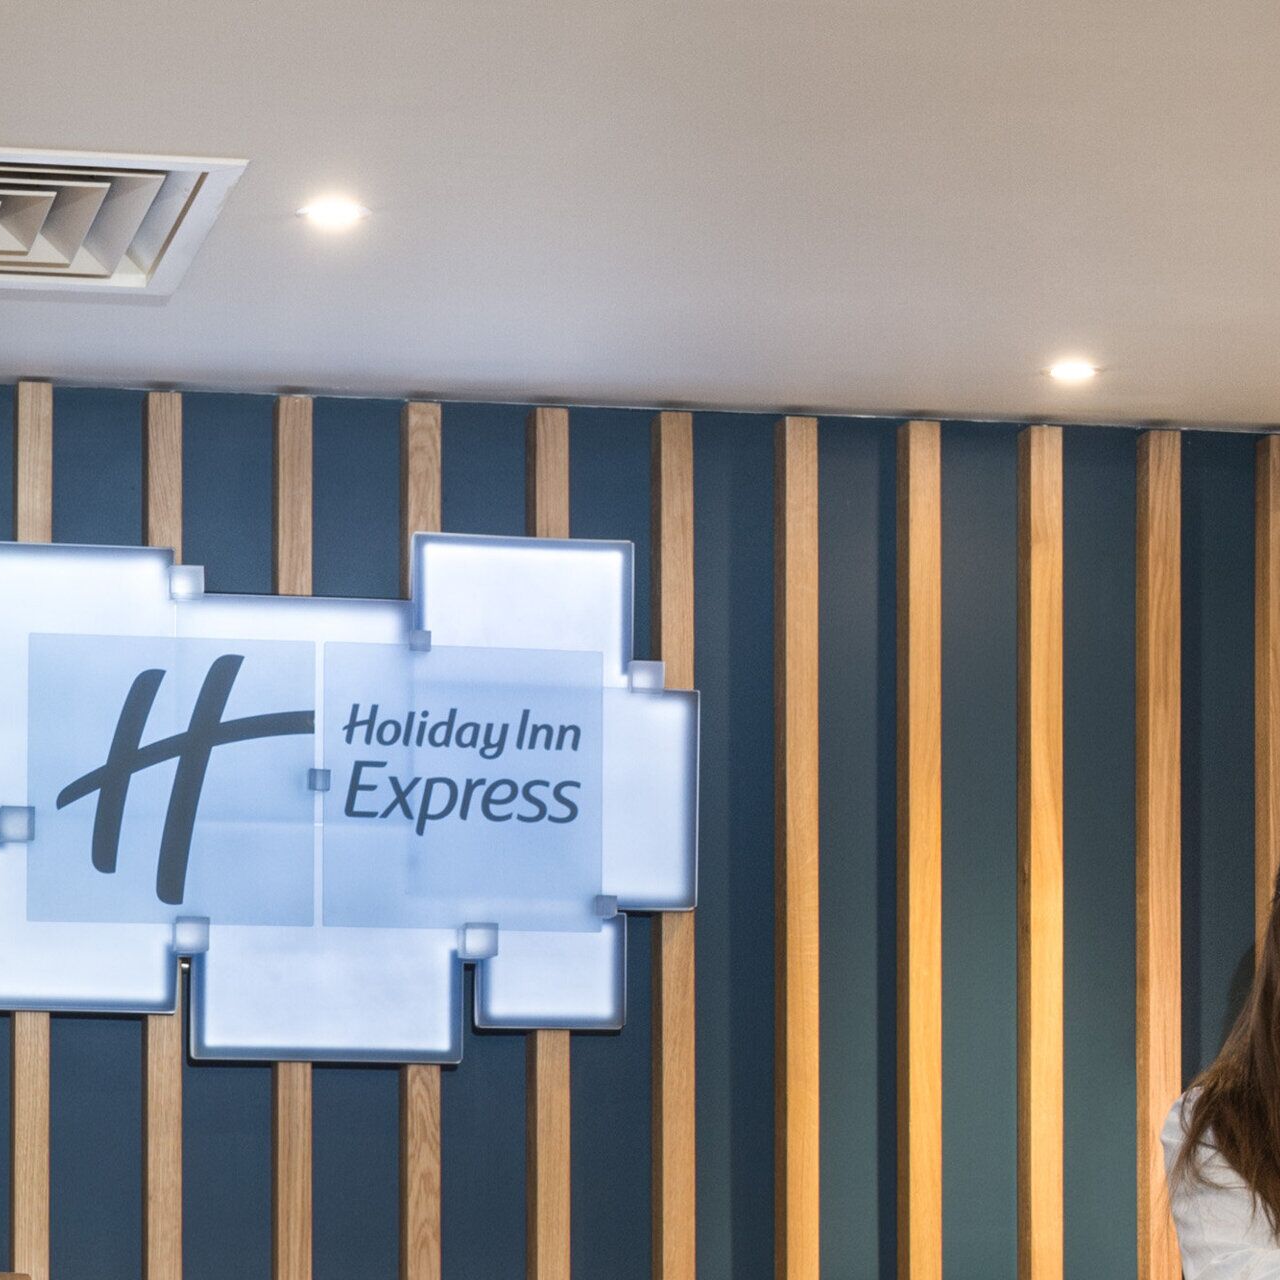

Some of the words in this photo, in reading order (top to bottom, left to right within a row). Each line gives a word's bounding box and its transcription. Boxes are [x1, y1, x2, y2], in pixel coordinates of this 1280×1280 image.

[342, 703, 509, 760] Holiday
[516, 709, 581, 751] Inn
[56, 654, 315, 905] H
[344, 760, 581, 836] Express
